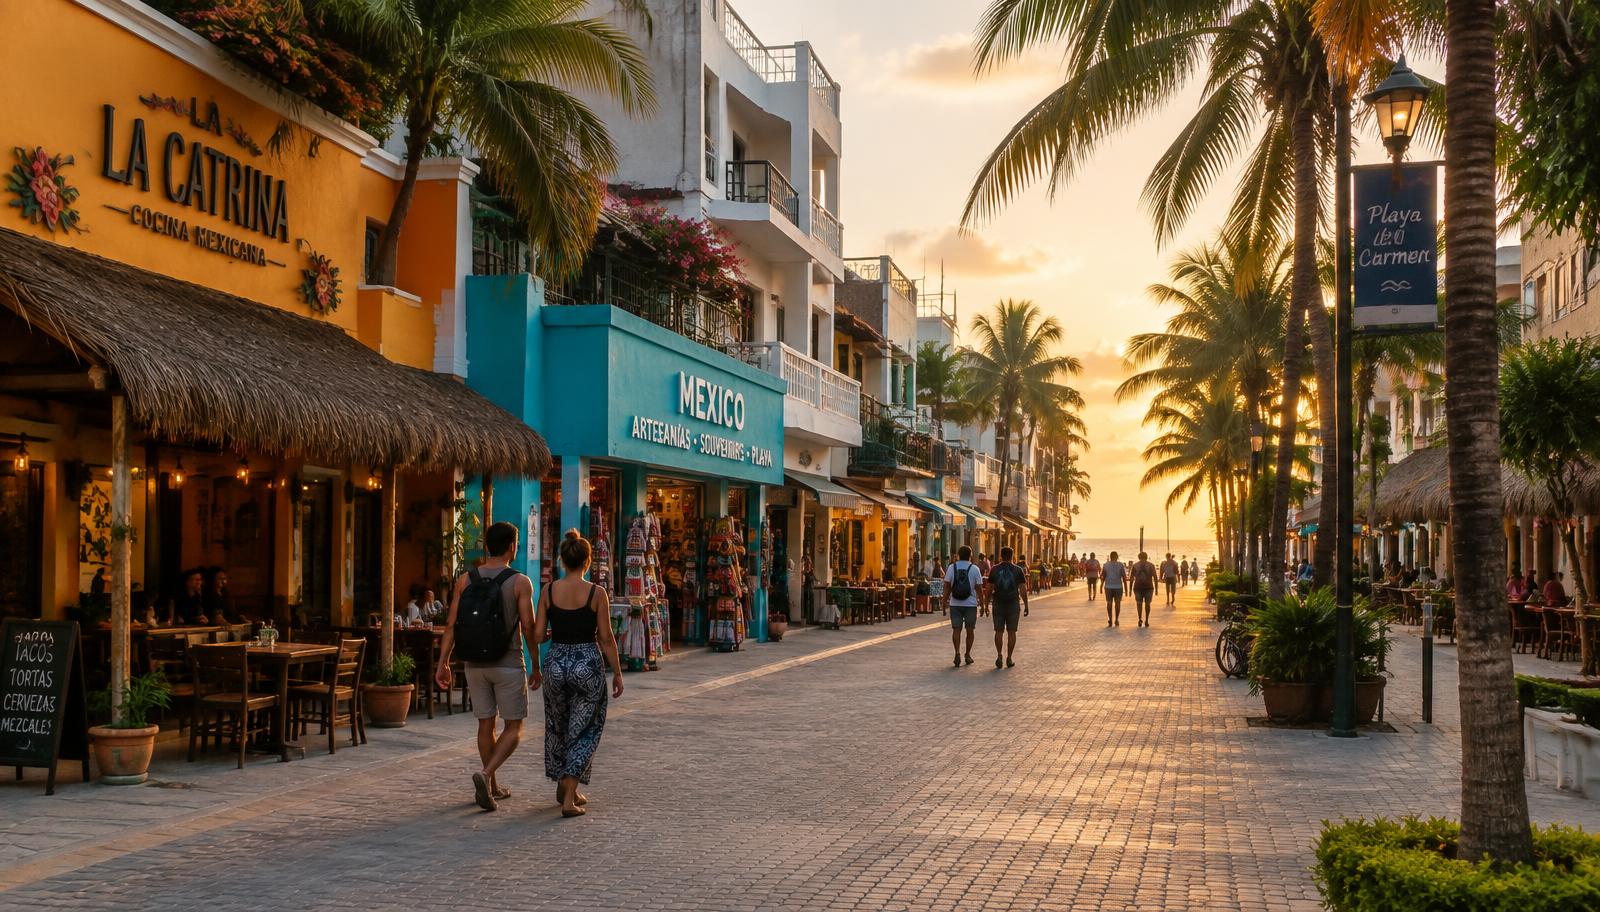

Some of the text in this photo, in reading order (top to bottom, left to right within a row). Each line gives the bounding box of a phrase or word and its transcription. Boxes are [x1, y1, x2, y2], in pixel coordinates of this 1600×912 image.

[190, 97, 223, 136] LA
[102, 104, 290, 243] LA CATRINA
[1367, 202, 1423, 228] Playa
[130, 204, 267, 266] COCINA MEXICANA
[1359, 248, 1431, 267] Carmen
[679, 370, 745, 431] MEXICO
[751, 445, 773, 467] PLAYA
[10, 668, 54, 688] TORTAS
